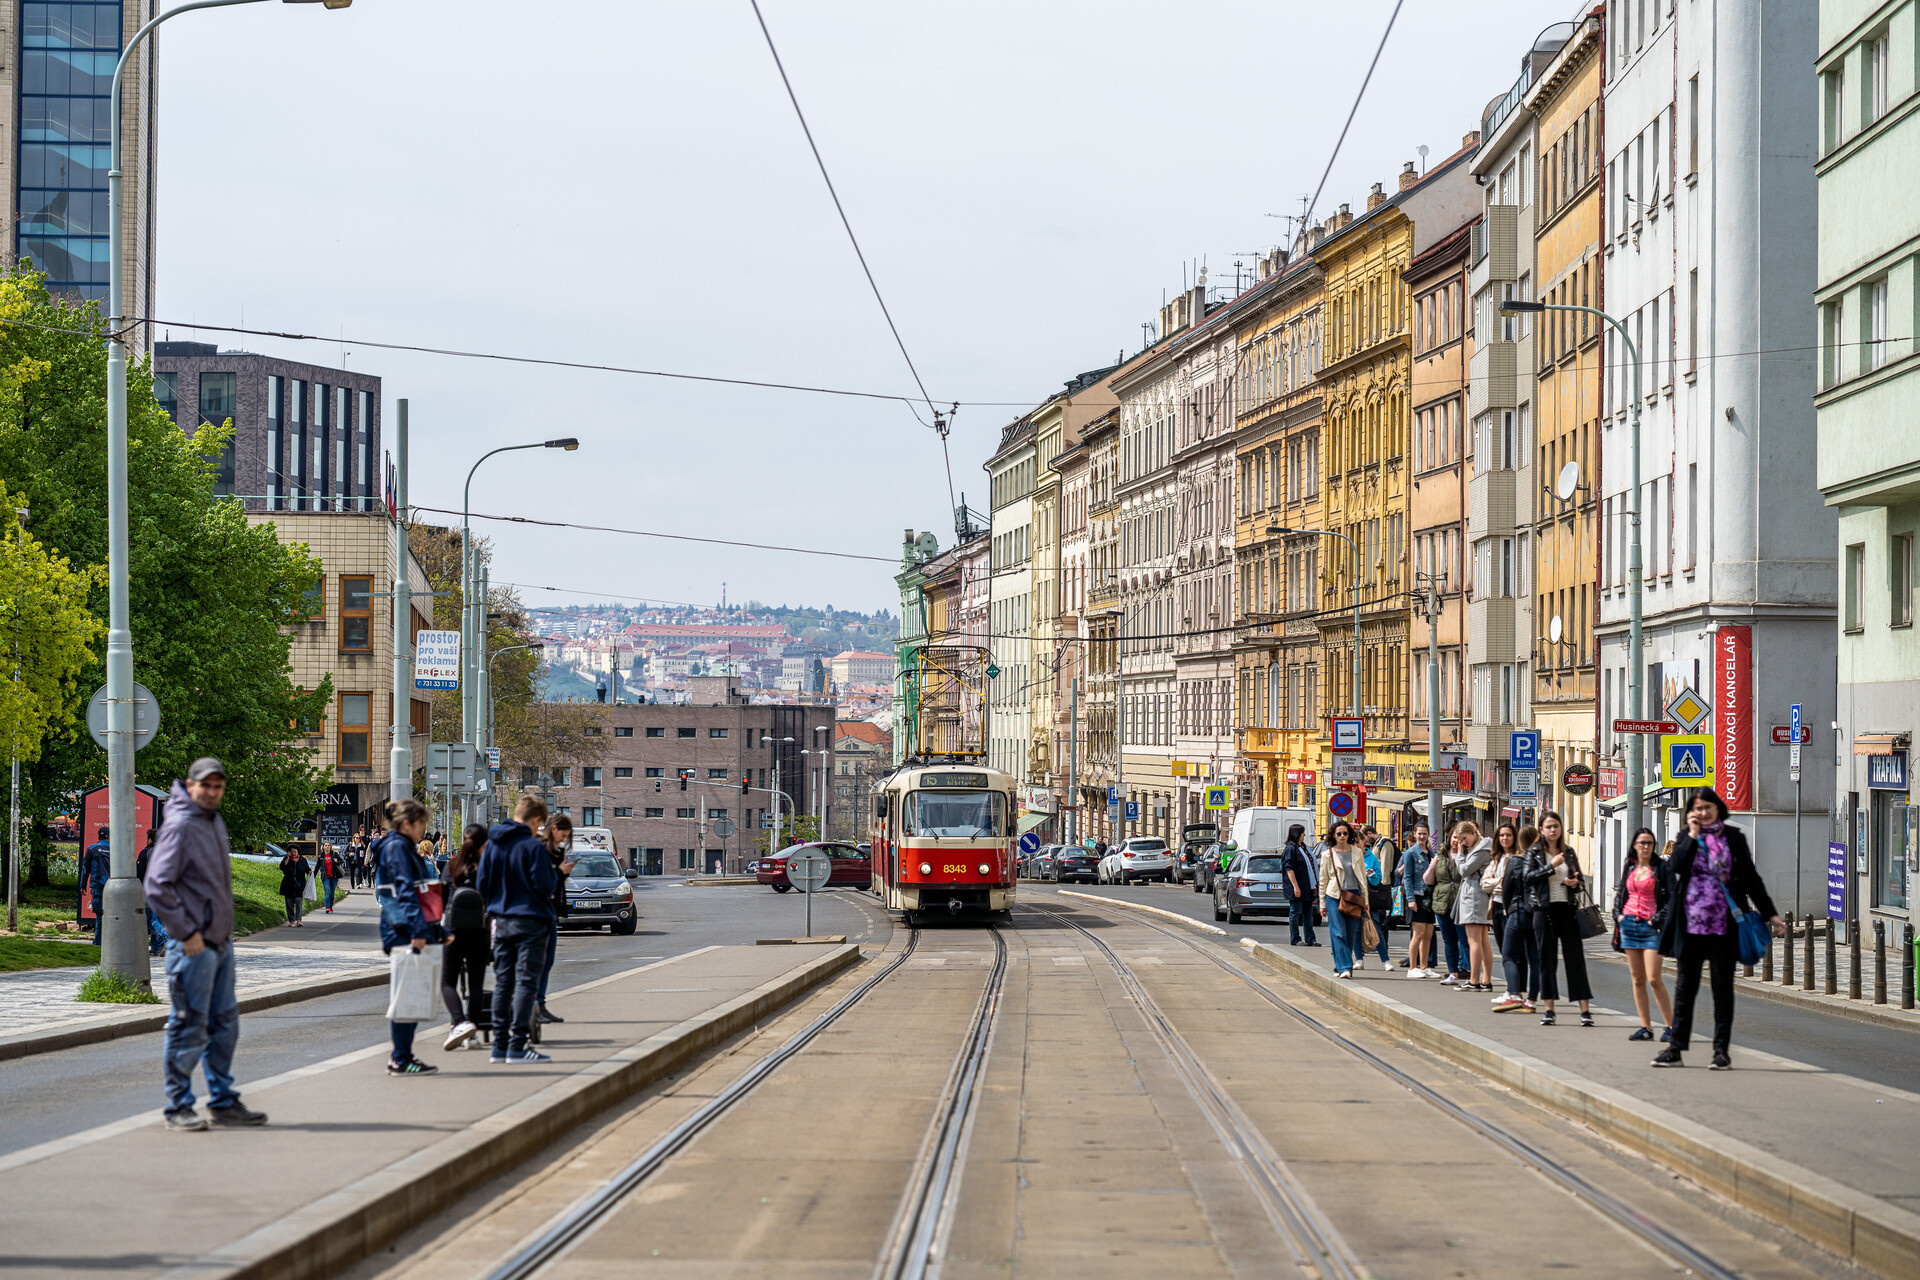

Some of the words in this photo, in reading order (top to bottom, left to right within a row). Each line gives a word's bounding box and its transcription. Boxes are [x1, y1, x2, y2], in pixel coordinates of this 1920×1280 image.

[419, 631, 458, 646] prostor
[418, 647, 434, 656] pro
[438, 646, 457, 655] vaši
[418, 656, 457, 665] reklamu
[1724, 636, 1736, 709] KANCELÁŘ
[1616, 722, 1660, 731] Husinecká
[1516, 737, 1532, 758] P
[1724, 712, 1736, 800] POJIŠŤOVACÍ
[1872, 756, 1902, 783] TRAFIKA
[923, 775, 938, 785] 15
[305, 791, 352, 805] ÁRNA
[943, 864, 967, 873] 8343
